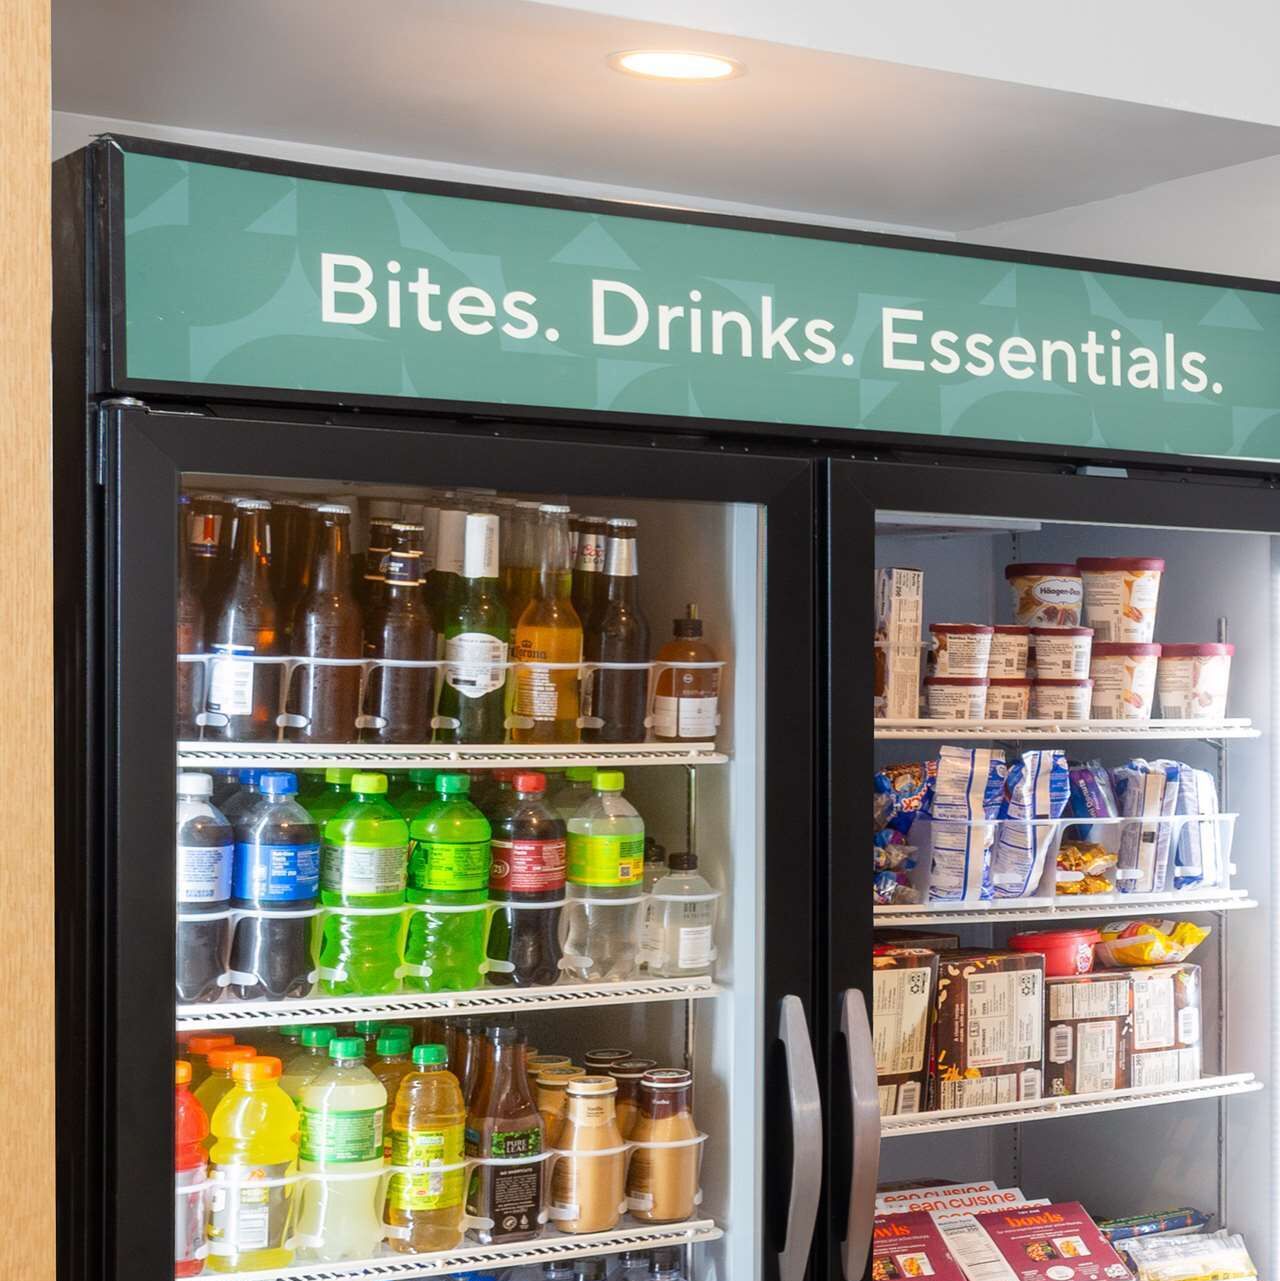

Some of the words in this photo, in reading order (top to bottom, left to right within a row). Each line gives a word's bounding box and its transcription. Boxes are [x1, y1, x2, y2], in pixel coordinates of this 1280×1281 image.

[320, 252, 560, 342] Bites.
[591, 279, 855, 367] Drinks.
[881, 306, 1224, 395] Essentials.
[949, 1191, 1017, 1209] cuisine
[1005, 1210, 1066, 1228] bowls
[873, 1223, 913, 1238] wls
